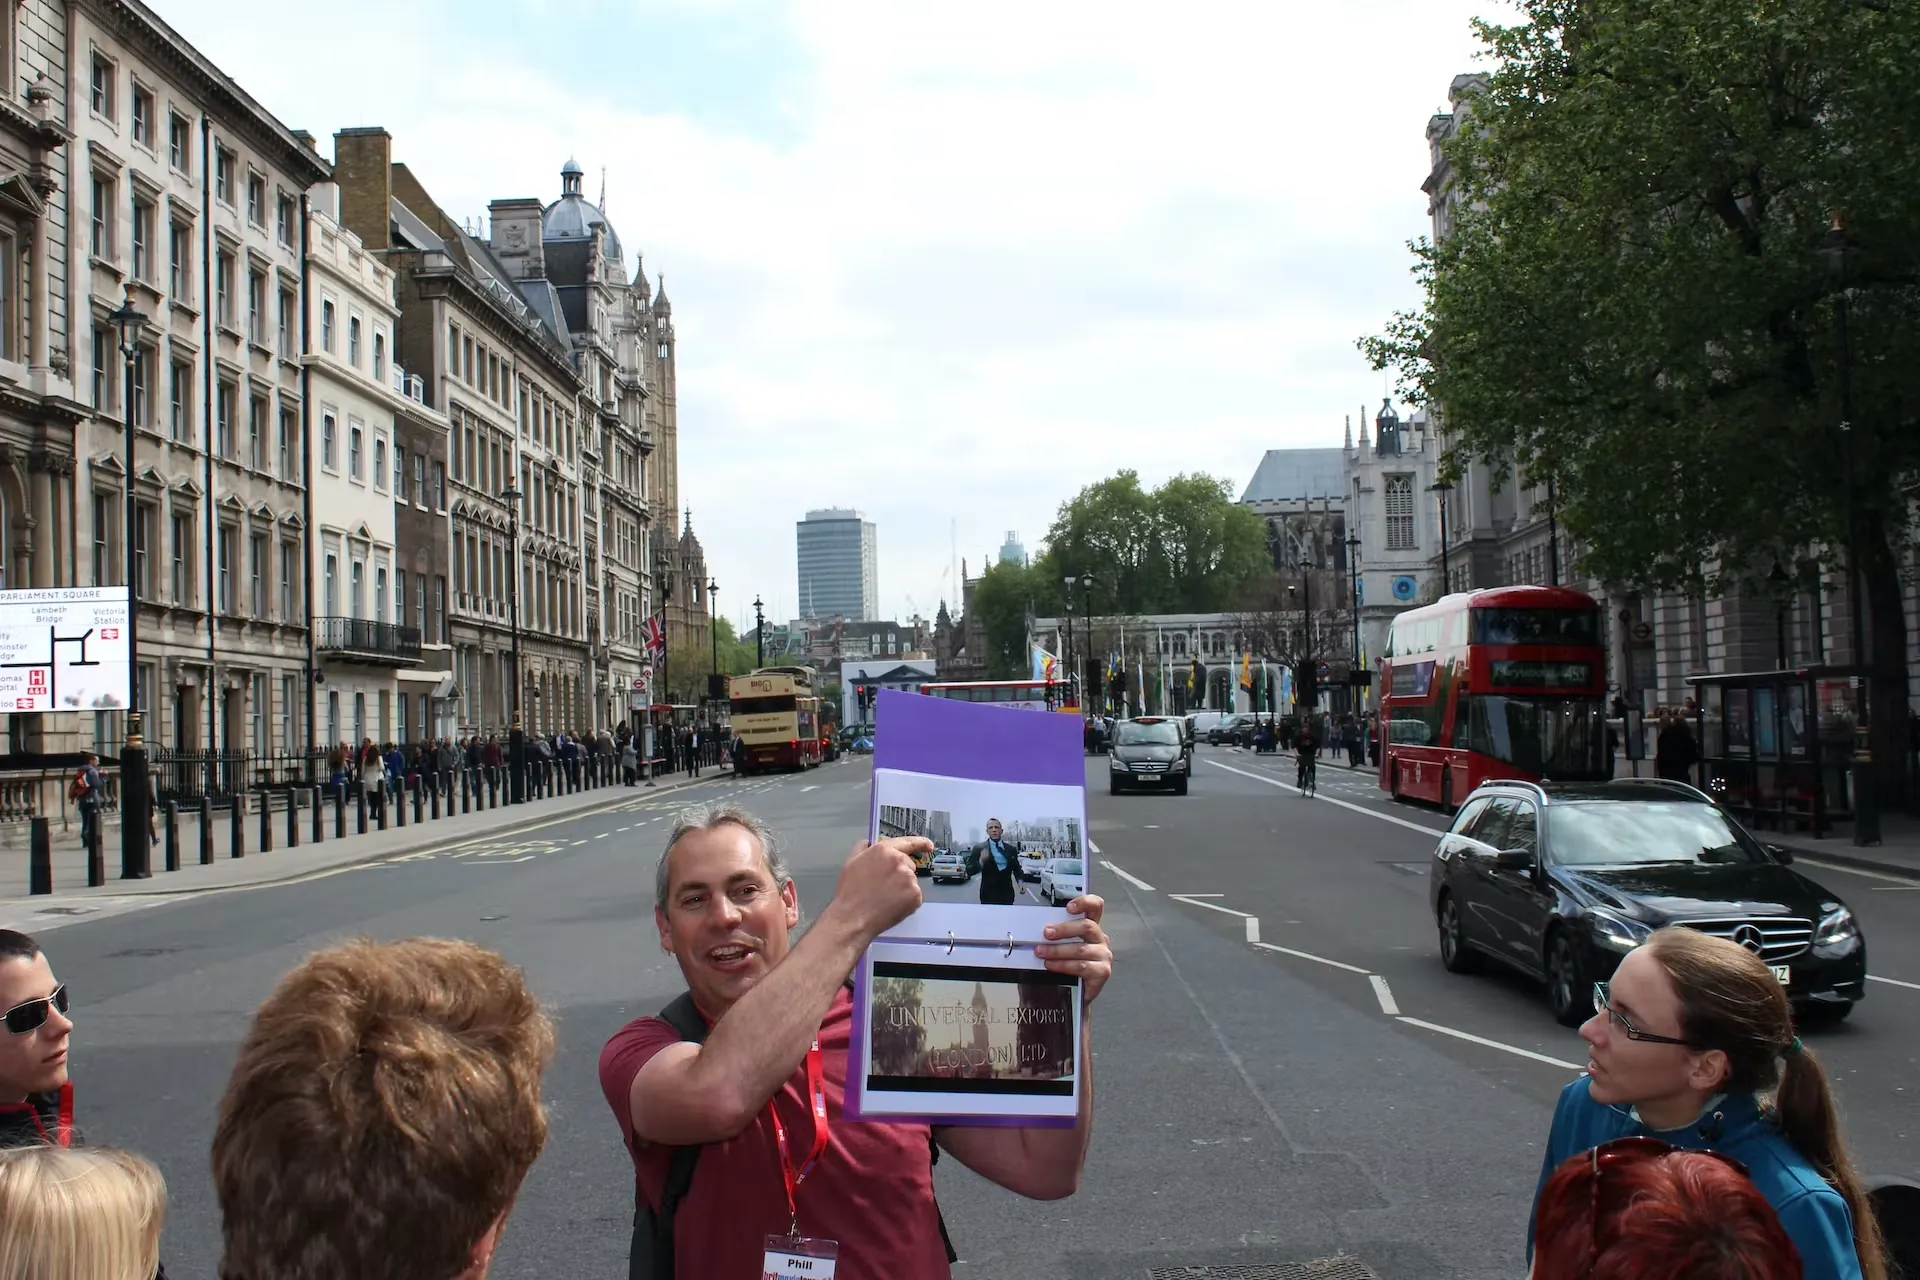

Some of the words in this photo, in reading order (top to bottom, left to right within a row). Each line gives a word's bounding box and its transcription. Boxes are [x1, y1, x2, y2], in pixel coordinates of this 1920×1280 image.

[1, 592, 59, 600] PARLIAMENT
[889, 1005, 1001, 1027] UNIVERSAL
[1007, 1006, 1065, 1025] EXPORTS
[1021, 1044, 1047, 1063] LTD
[788, 1259, 813, 1270] Phill
